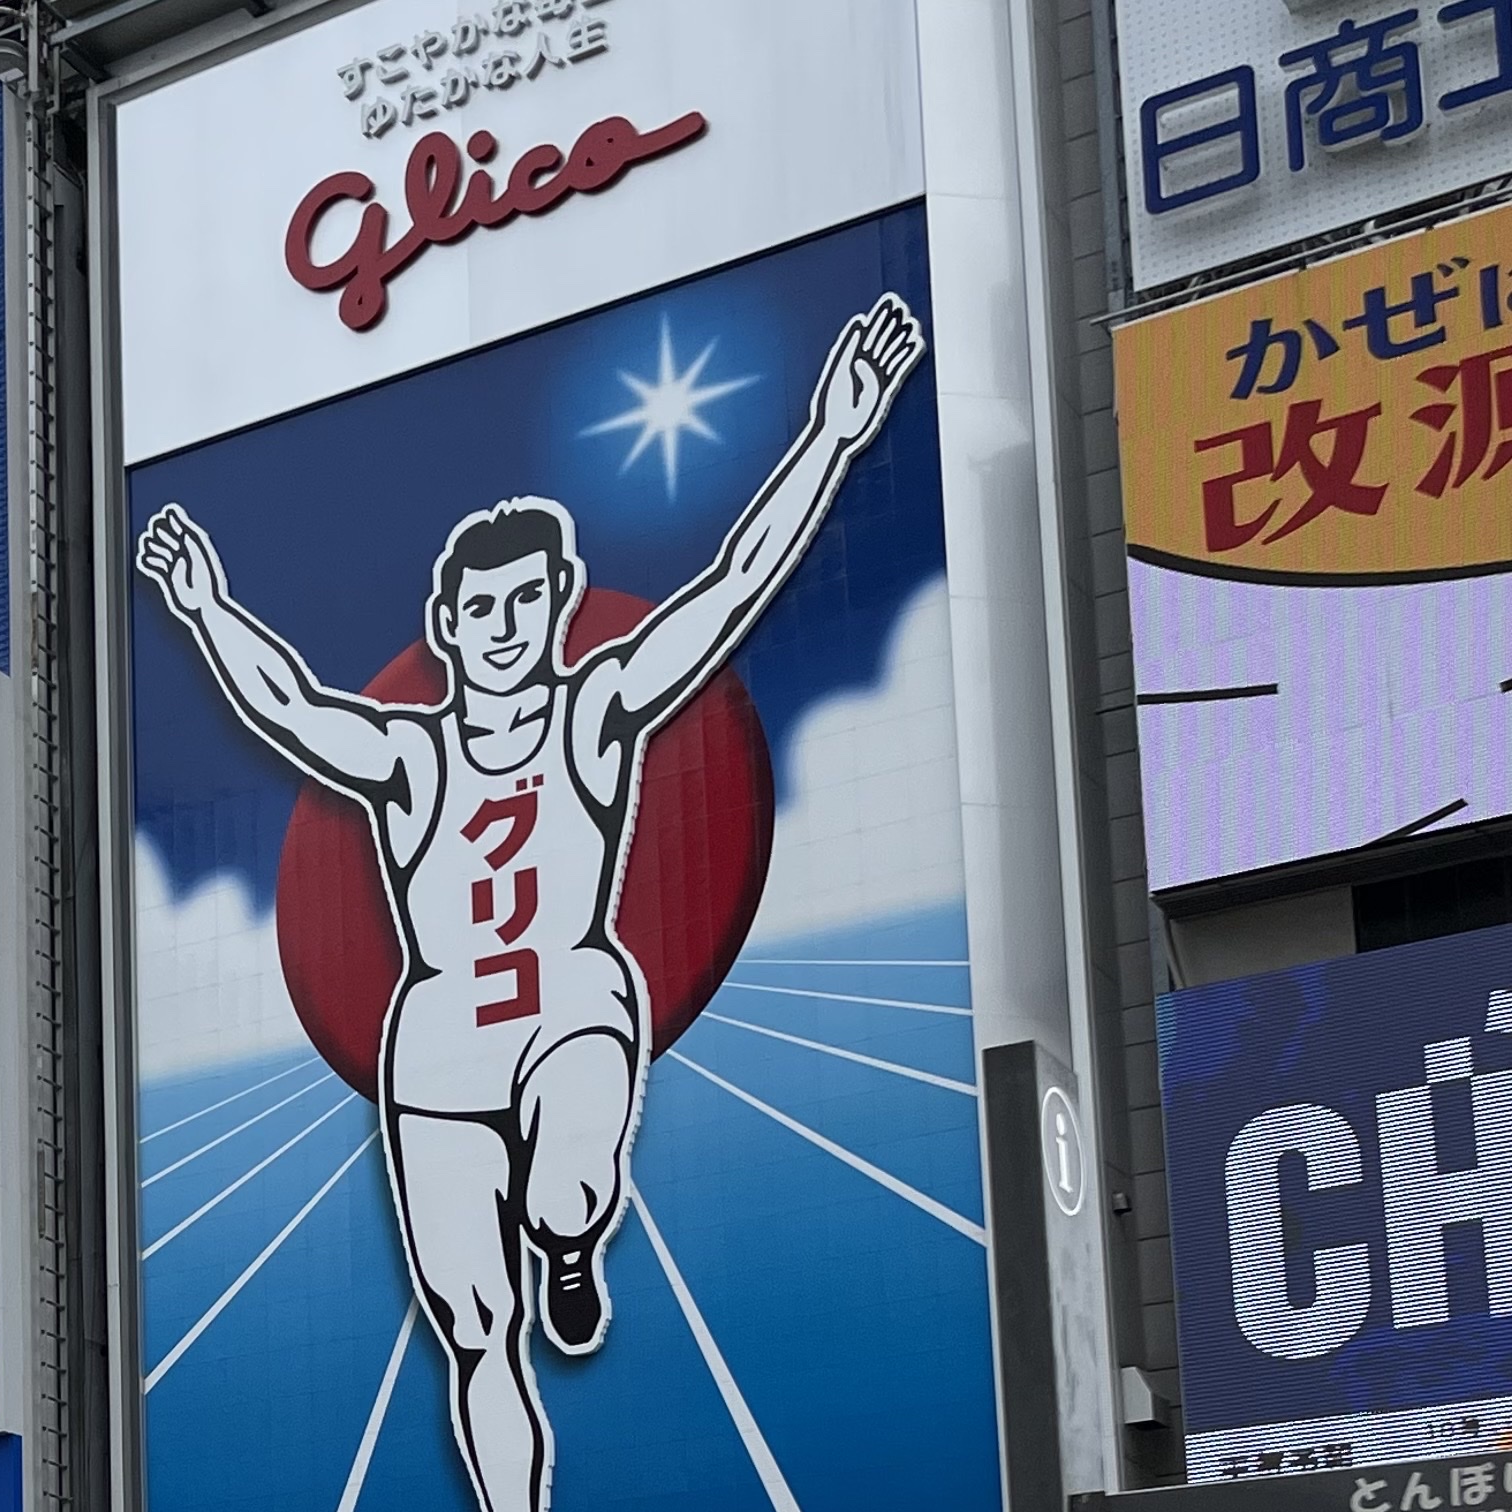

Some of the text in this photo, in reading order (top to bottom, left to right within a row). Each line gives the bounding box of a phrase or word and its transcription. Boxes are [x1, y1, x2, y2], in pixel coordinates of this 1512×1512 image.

[359, 17, 610, 139] ゆたかな人生
[459, 773, 544, 1028] グリコ
